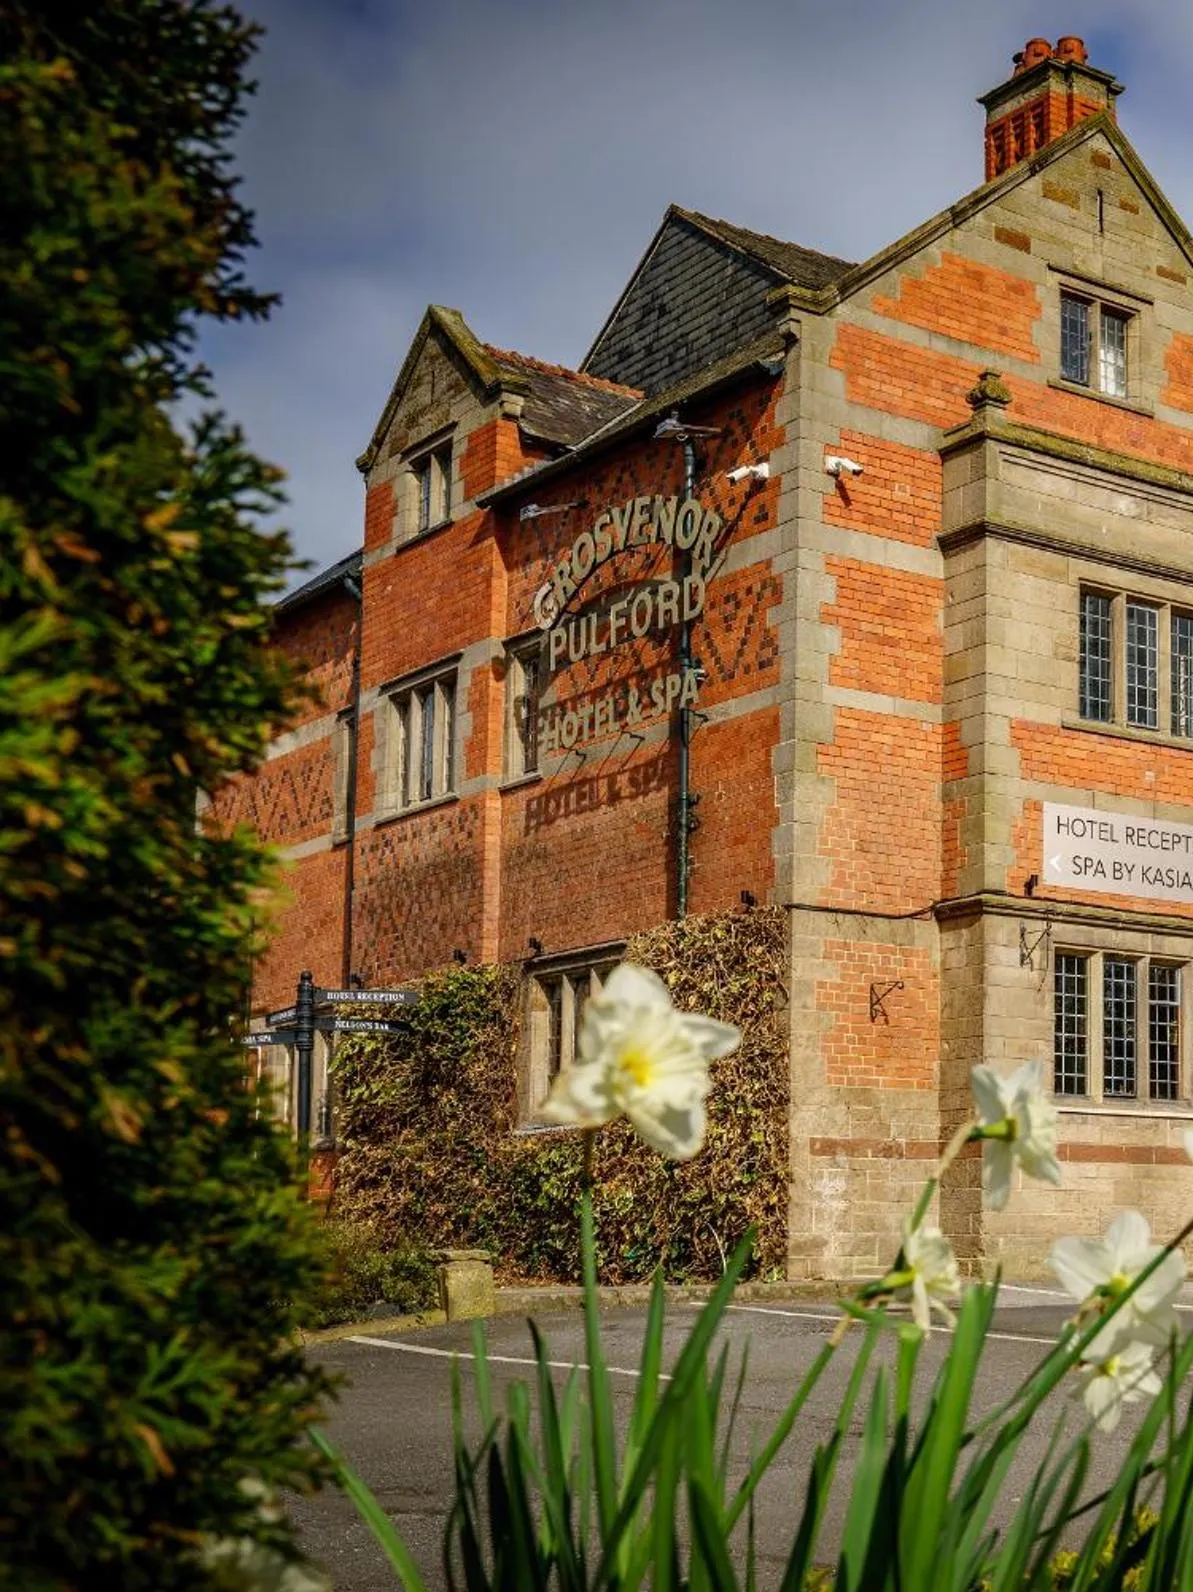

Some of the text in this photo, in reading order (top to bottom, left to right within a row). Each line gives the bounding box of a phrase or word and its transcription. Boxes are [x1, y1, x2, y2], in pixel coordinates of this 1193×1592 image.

[534, 495, 723, 630] GROSVENOR
[550, 574, 706, 671] PULFORD
[538, 667, 699, 751] HOTEL & SPA
[1057, 815, 1119, 843] HOTEL
[1071, 855, 1193, 891] SPA BY KASIA
[326, 991, 405, 1002] HOTEL RECEPTION
